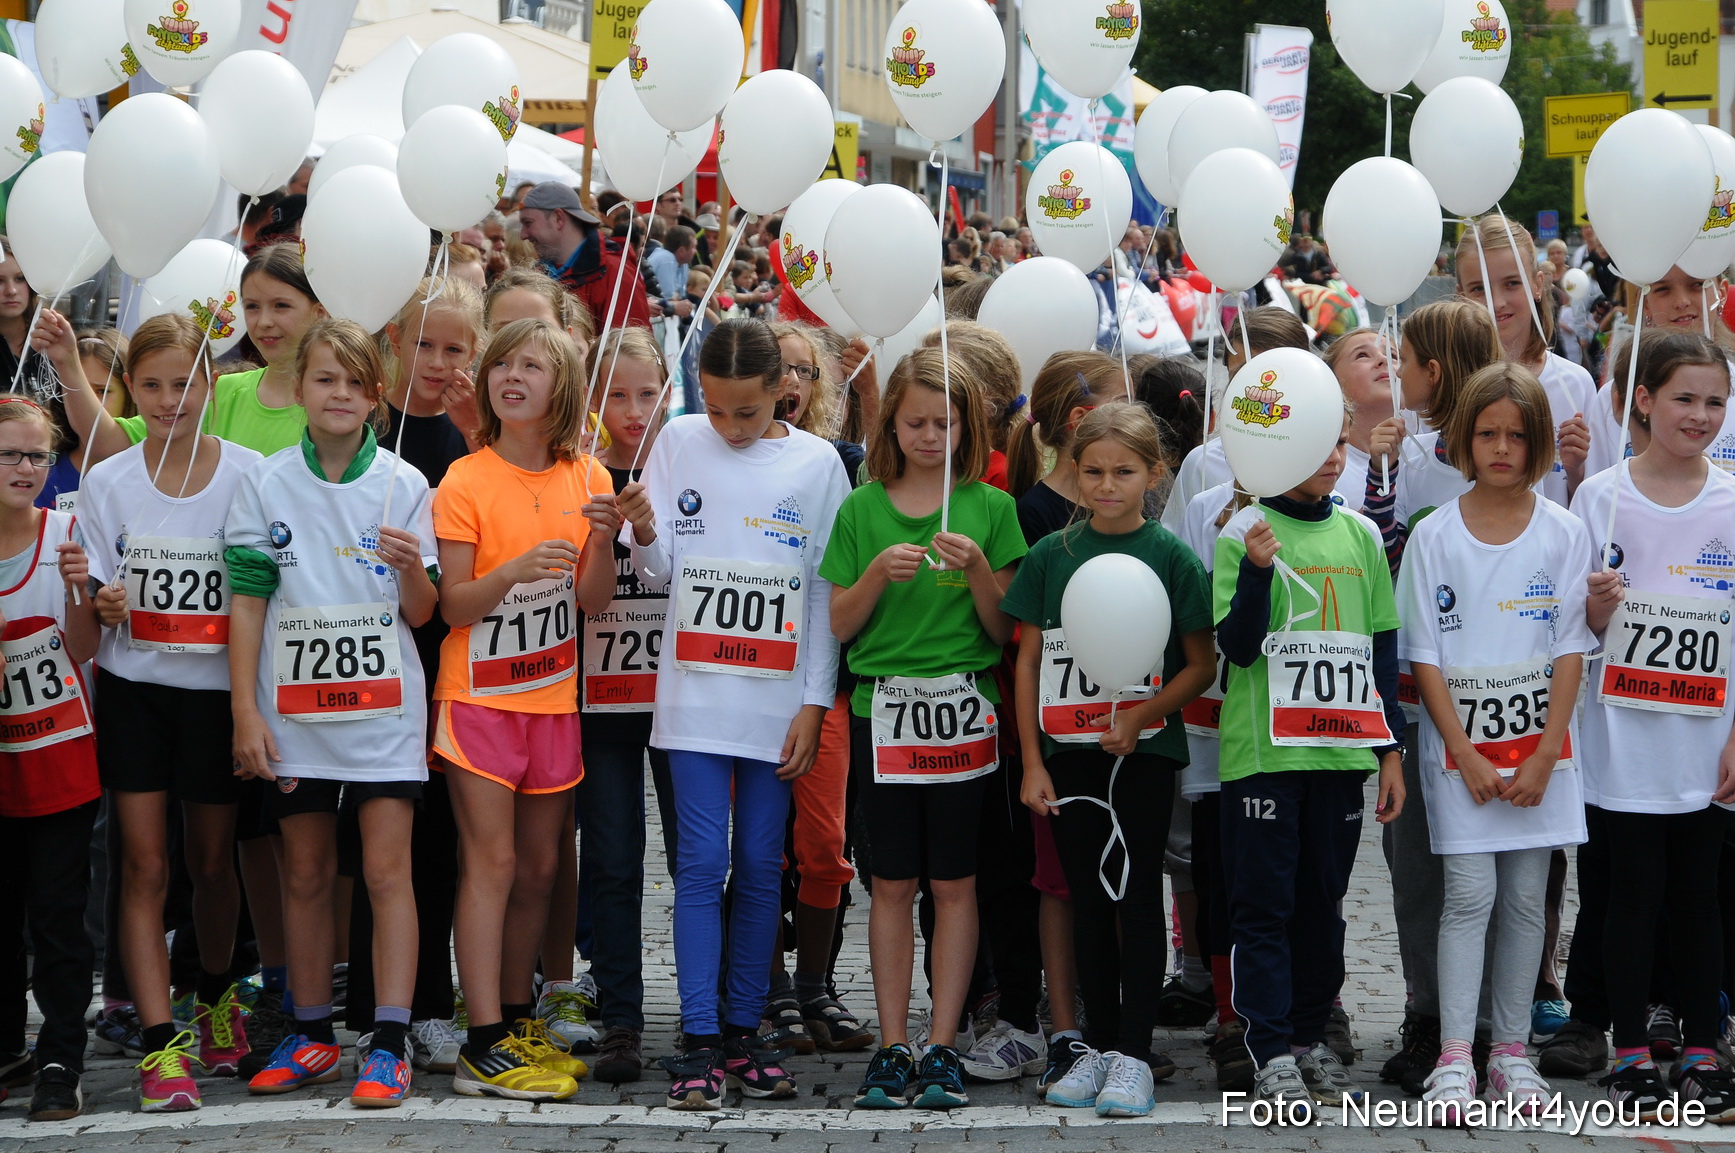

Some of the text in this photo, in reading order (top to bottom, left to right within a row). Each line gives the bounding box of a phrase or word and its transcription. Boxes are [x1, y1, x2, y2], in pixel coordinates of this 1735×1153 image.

[1647, 28, 1717, 49] Jugend-
[1666, 49, 1698, 66] lauf
[1552, 112, 1624, 126] Schnupper-
[1576, 128, 1600, 140] lauf
[1268, 431, 1290, 441] steigen
[743, 517, 762, 529] 14.
[160, 549, 219, 562] Neumarkt
[335, 547, 353, 557] 14.
[683, 567, 785, 588] PARTL Neumarkt
[1667, 565, 1687, 576] 14.
[131, 568, 222, 612] 7328
[513, 584, 565, 605] Neumarkt
[692, 586, 786, 635] 7001
[1497, 599, 1517, 612] 14.
[1659, 605, 1718, 622] Neumarkt
[278, 616, 375, 632] PARTL Neumarkt
[482, 600, 569, 657] 7170
[587, 612, 623, 625] PARTL
[788, 632, 798, 640] W
[714, 641, 758, 662] Julia
[1271, 643, 1363, 665] PARTL Neumarkt
[1624, 622, 1720, 674] 7280
[285, 635, 386, 682] 7285
[511, 657, 556, 680] Merle
[390, 668, 399, 677] W
[1284, 660, 1369, 705] 7017
[1448, 670, 1541, 691] PARTL Neumarkt
[594, 681, 635, 700] Emily
[876, 684, 912, 699] PARTL
[1613, 673, 1716, 702] Anna-Maria
[317, 688, 359, 708] Lena
[885, 697, 985, 741] 7002
[1458, 688, 1549, 741] 7335
[1306, 714, 1362, 742] Janika
[908, 752, 971, 770] Jasmin
[1242, 796, 1277, 820] 112
